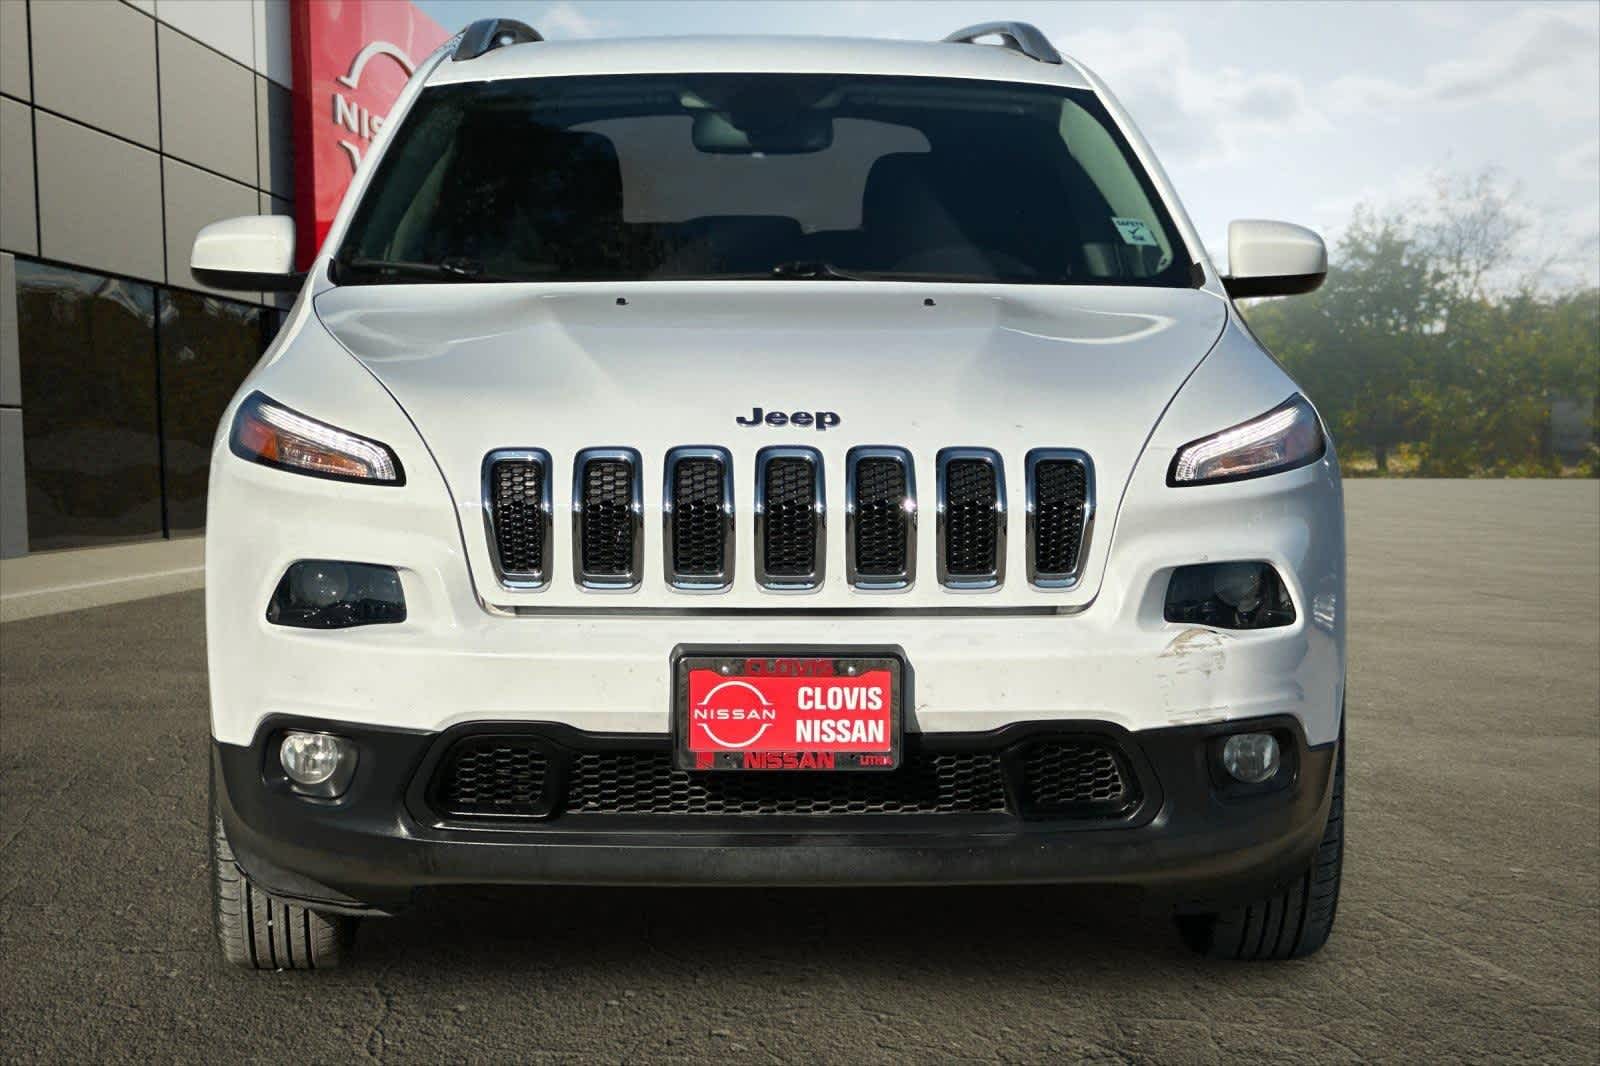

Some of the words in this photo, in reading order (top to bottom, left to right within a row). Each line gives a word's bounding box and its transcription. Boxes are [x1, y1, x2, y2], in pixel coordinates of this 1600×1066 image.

[736, 407, 841, 431] Jeep
[797, 686, 883, 711] CLOVIS
[694, 708, 776, 720] NISSAN
[795, 719, 884, 743] NISSAN
[743, 751, 836, 769] NISSAN
